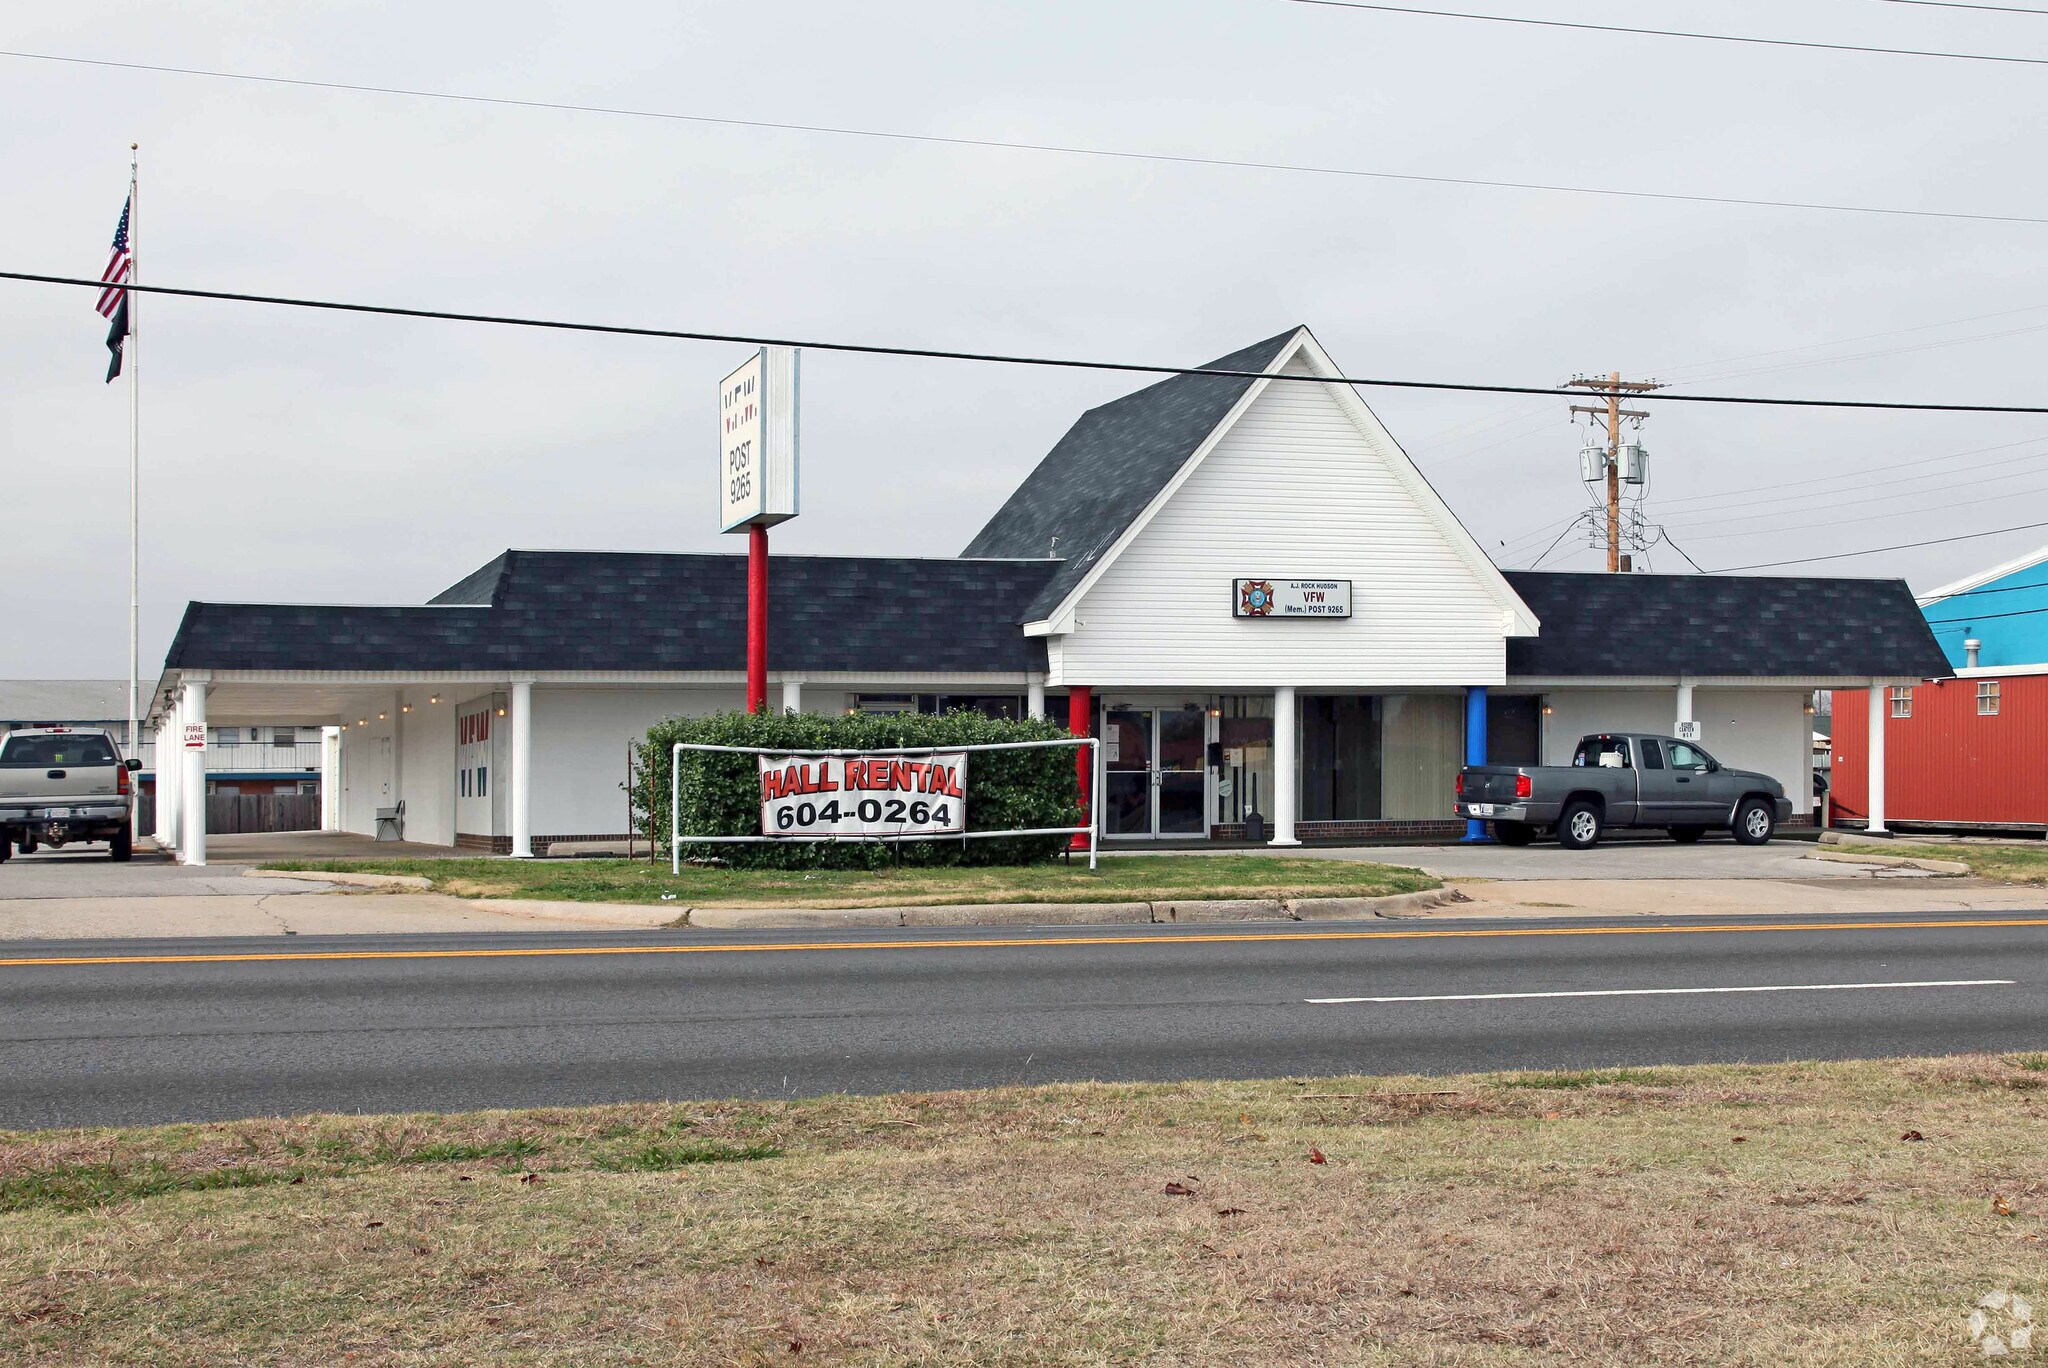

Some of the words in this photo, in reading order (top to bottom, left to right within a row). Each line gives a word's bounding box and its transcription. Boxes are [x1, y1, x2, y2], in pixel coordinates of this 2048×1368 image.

[729, 440, 751, 475] POST
[730, 471, 751, 504] 9265
[1284, 604, 1307, 614] (Mem.)
[1308, 605, 1326, 613] POST
[1327, 605, 1344, 613] 9265
[1303, 592, 1325, 602] VFW
[763, 761, 838, 802] HALL
[844, 760, 963, 799] RENTAL
